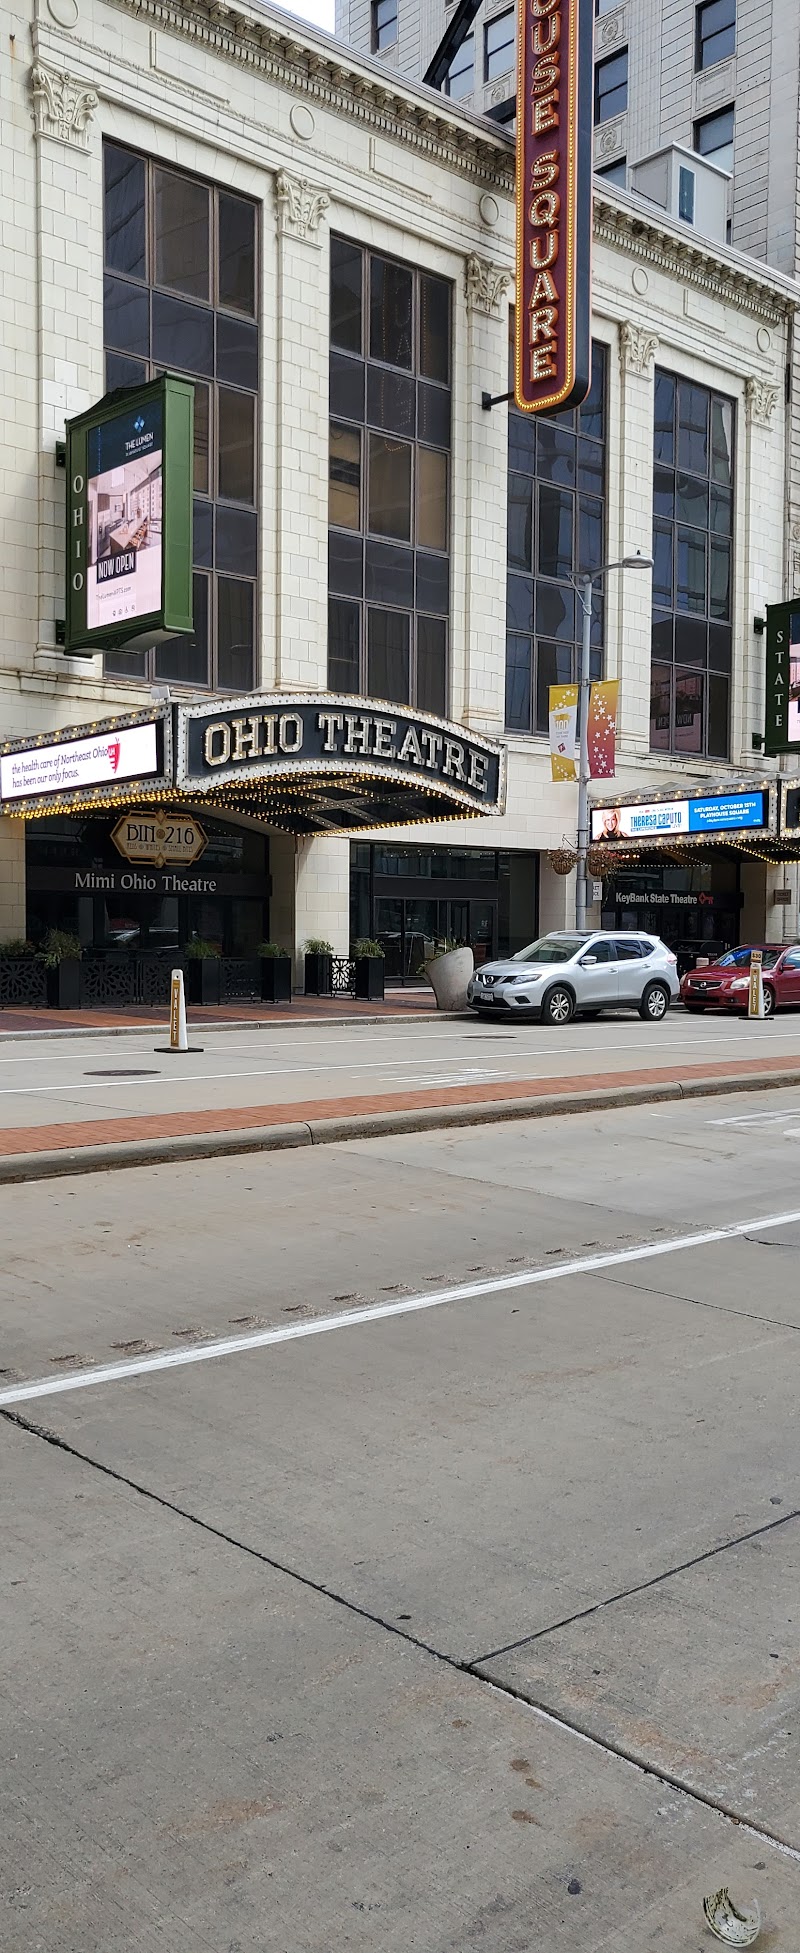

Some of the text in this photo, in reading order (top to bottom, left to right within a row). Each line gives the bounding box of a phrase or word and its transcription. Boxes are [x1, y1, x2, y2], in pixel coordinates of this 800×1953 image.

[528, 149, 560, 382] SQUARE
[125, 439, 136, 451] THE
[136, 432, 154, 447] LUMEN
[73, 475, 84, 591] OHIO
[98, 552, 134, 579] NOW OPEN
[774, 630, 785, 727] STATE
[12, 746, 108, 774] the health care of Northeast Ohio
[204, 712, 490, 794] OHIO THEATRE
[12, 768, 79, 788] has been our only focus.
[700, 811, 728, 819] PLAYHOUSE
[126, 824, 194, 845] BIN 216
[75, 873, 217, 892] Mimi Ohio Theatre
[616, 892, 698, 905] KeyBank State Theatre
